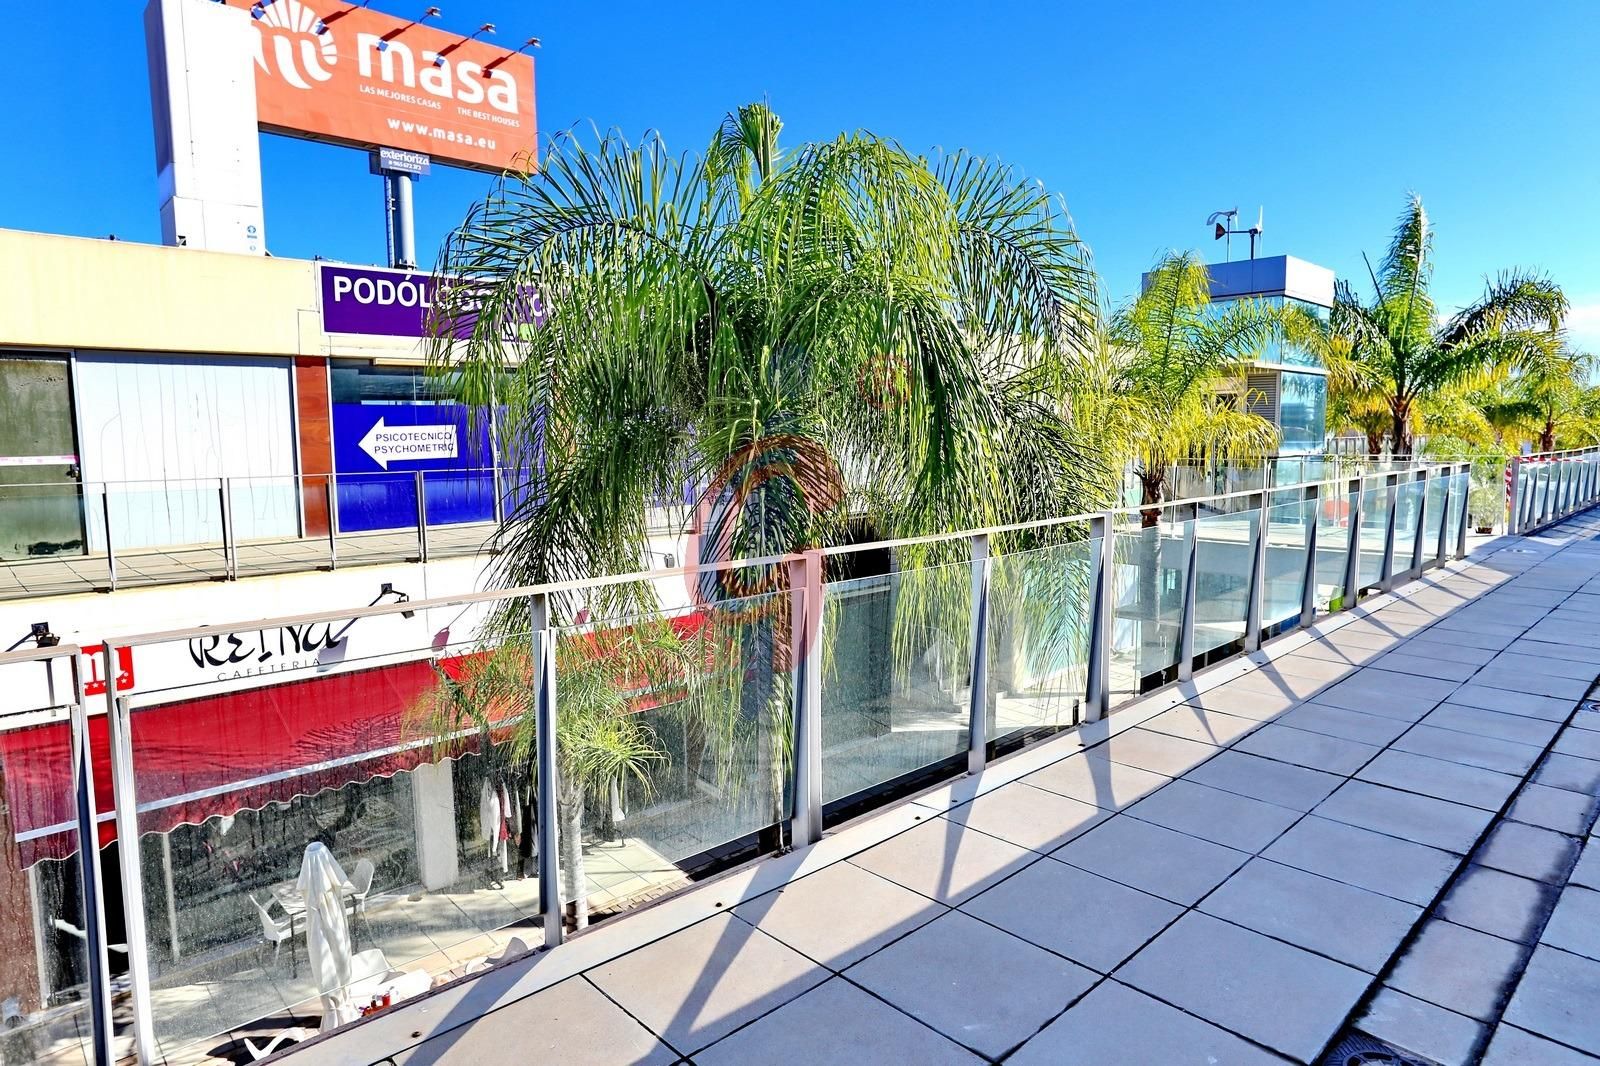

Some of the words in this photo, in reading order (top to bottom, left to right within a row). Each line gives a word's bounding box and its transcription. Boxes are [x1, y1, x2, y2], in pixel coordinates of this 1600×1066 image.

[357, 32, 519, 114] masa
[359, 84, 375, 95] LAS
[376, 88, 416, 104] MEJORES
[417, 97, 441, 110] CASAS
[457, 107, 471, 117] THE
[473, 110, 490, 120] BEST
[491, 114, 520, 127] HOUSES
[386, 117, 496, 149] www.masa.eu
[380, 149, 430, 166] exterioriza
[375, 432, 452, 442] PSICOTECNICO
[374, 443, 453, 454] PSYCHOMETRIC
[217, 658, 320, 681] CAFETERIA
